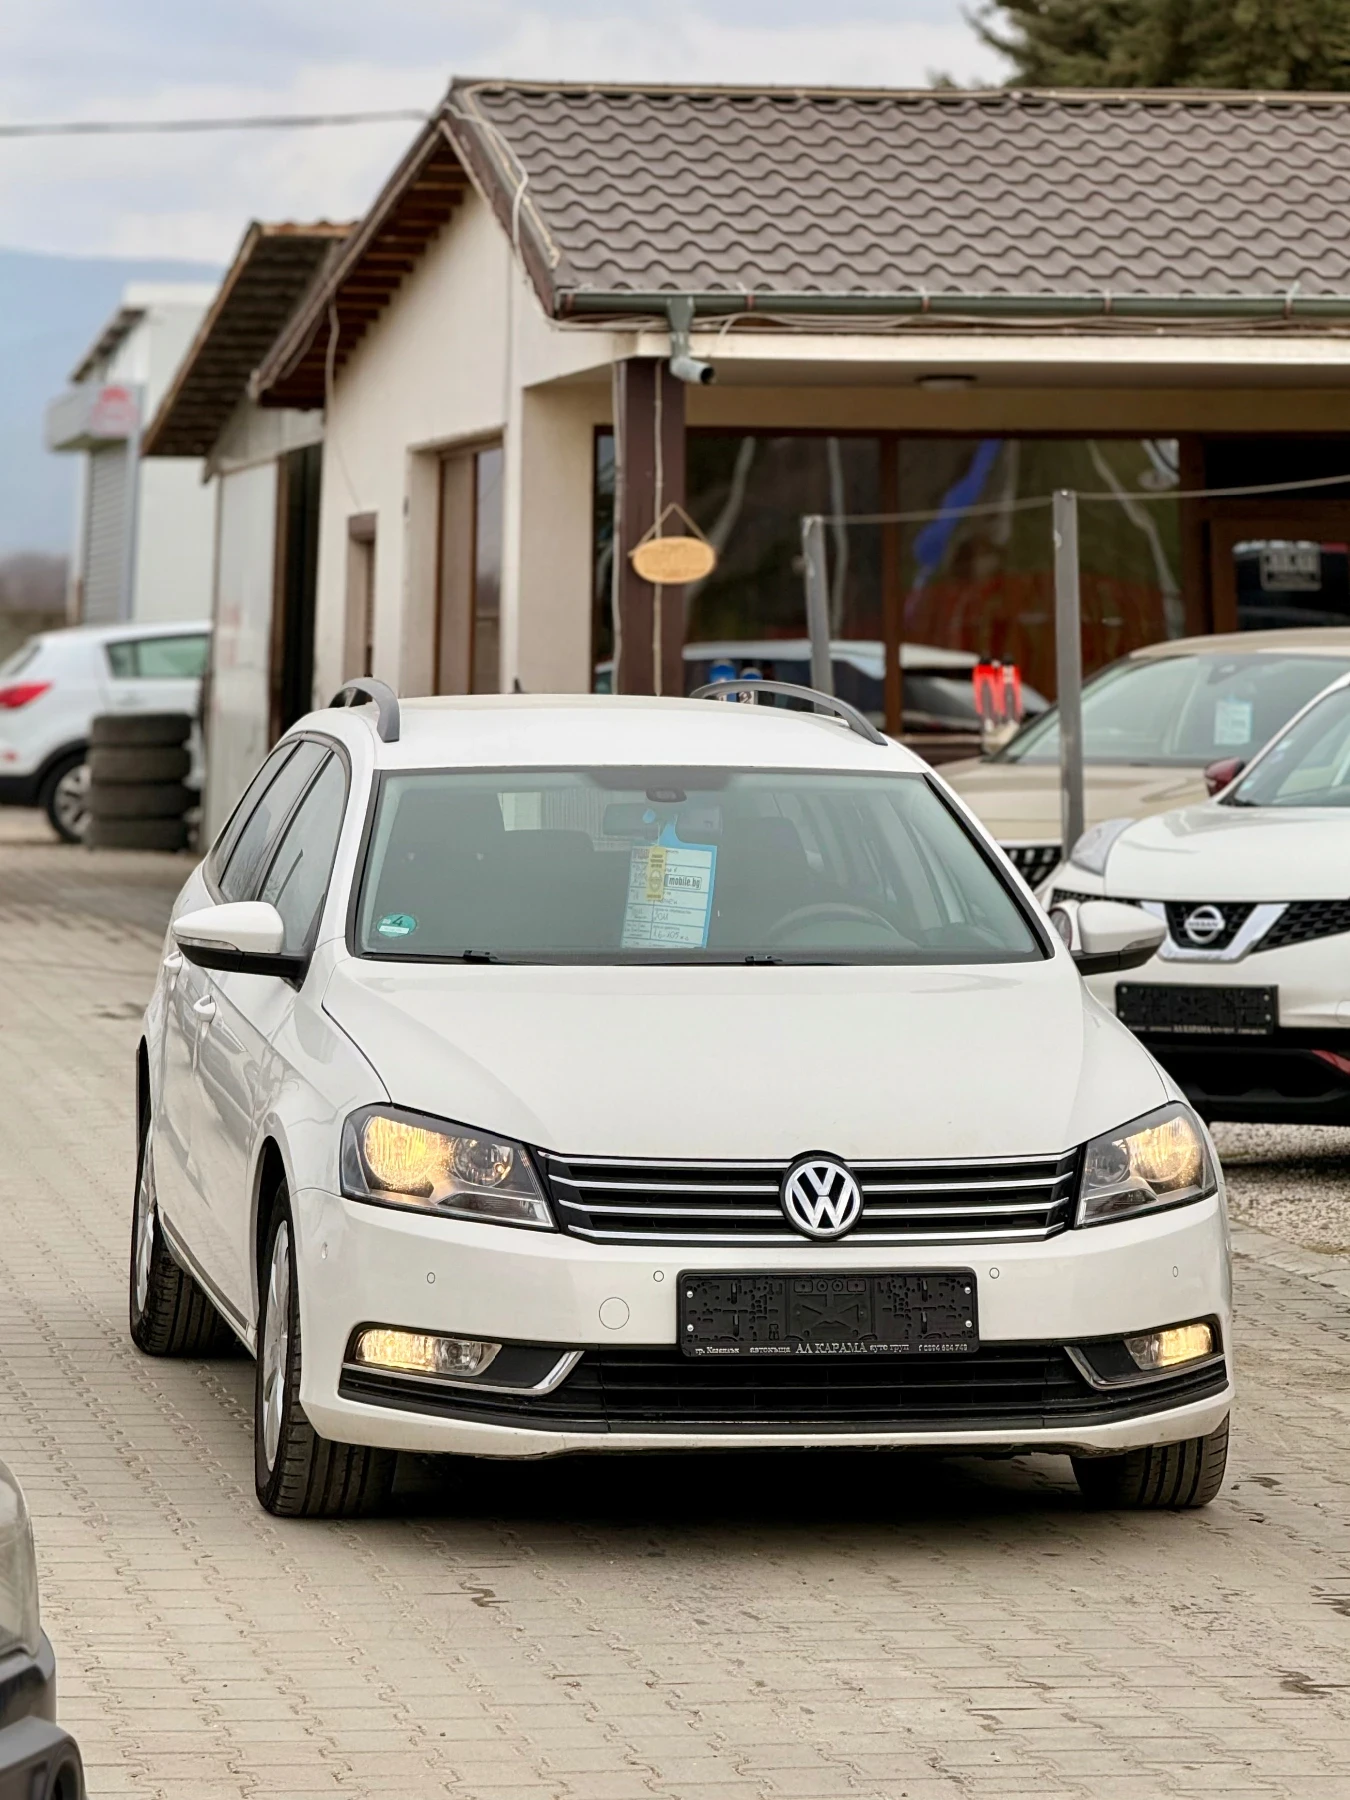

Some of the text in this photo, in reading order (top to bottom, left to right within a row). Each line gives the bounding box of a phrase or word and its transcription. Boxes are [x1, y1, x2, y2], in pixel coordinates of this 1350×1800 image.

[668, 876, 700, 888] mobile.bg
[392, 915, 404, 927] 4
[795, 1343, 814, 1354] АЛ
[814, 1342, 868, 1354] КАРАМА
